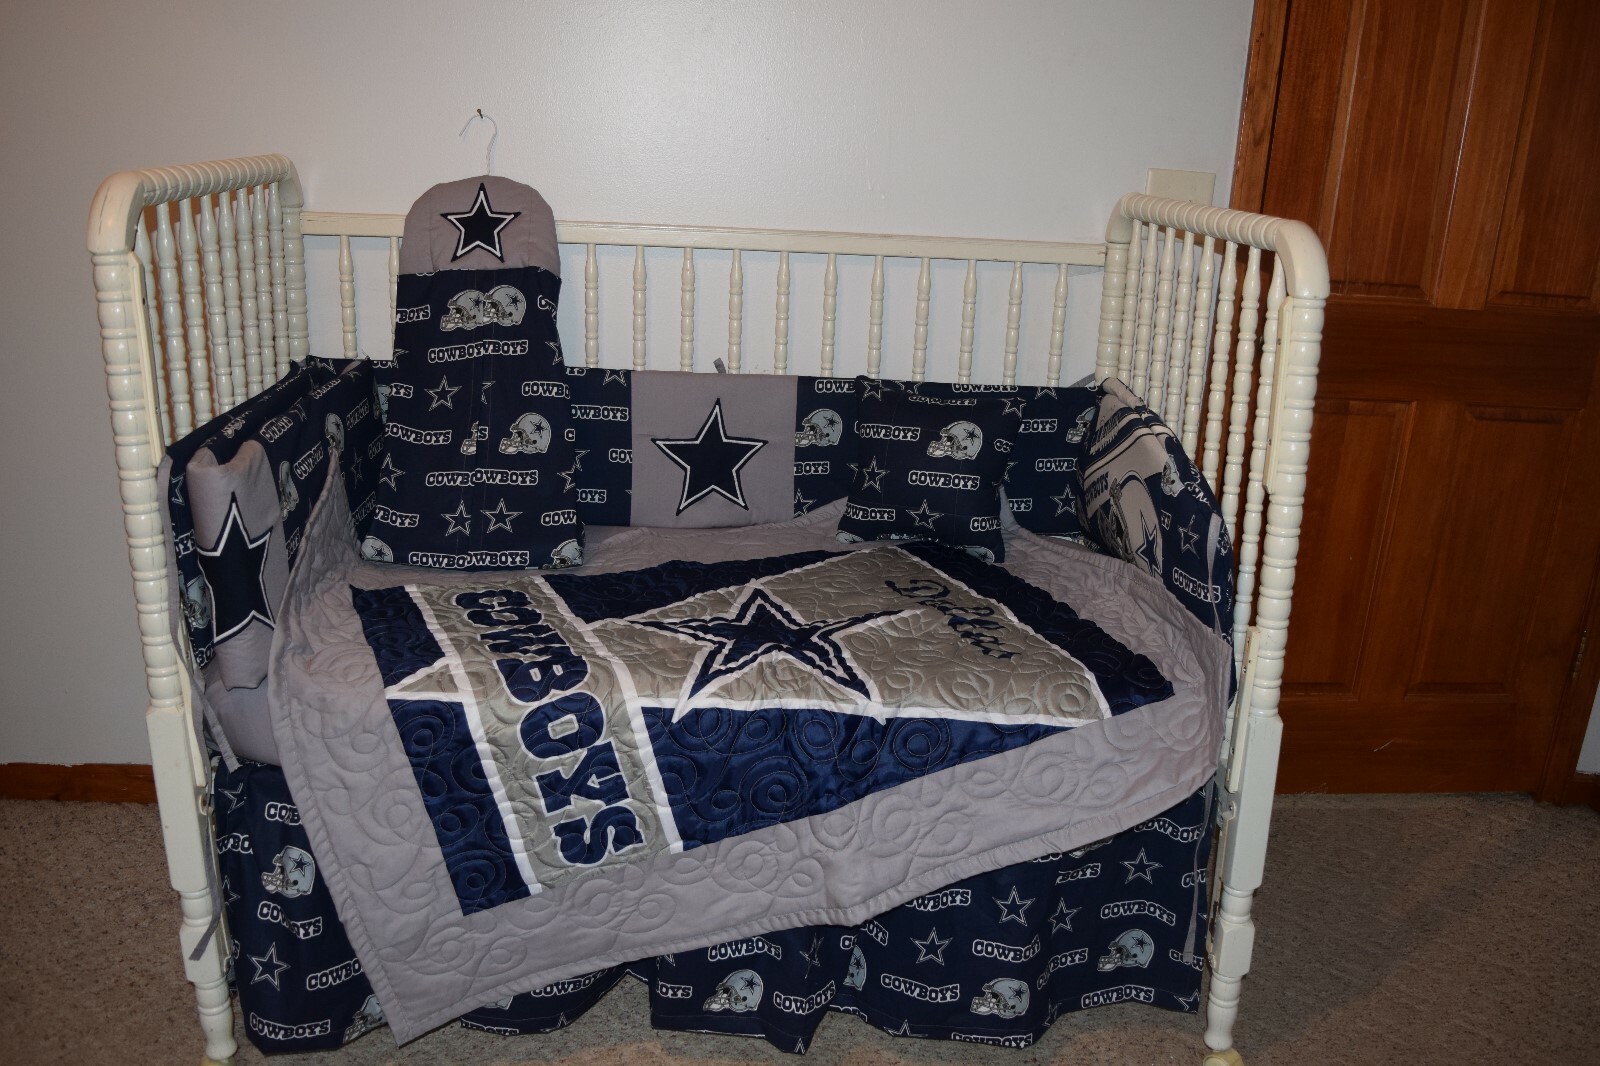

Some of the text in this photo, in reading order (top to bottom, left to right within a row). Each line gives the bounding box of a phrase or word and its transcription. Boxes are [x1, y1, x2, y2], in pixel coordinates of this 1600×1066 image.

[396, 304, 431, 323] BOYS
[522, 381, 570, 399] COWBO
[815, 379, 856, 394] COWB
[570, 405, 629, 421] OWBOYS
[1019, 419, 1057, 432] BOYS
[794, 461, 830, 475] BOYS
[1035, 458, 1079, 472] COWB
[908, 470, 980, 490] COWBOYS
[373, 505, 419, 527] BOYS
[845, 501, 896, 521] OWBOYS
[453, 588, 647, 867] COWBOYS
[1055, 862, 1101, 886] BOYS
[905, 888, 971, 911] WBOYS
[1101, 900, 1176, 926] COWBOYS
[708, 936, 782, 962] COWBOYS
[306, 958, 364, 991] COWBO
[773, 980, 836, 1015] COWBOYS
[881, 973, 960, 1003] COWBOYS
[1081, 984, 1154, 1009] COWBOYS
[249, 1011, 331, 1041] COWBOYS
